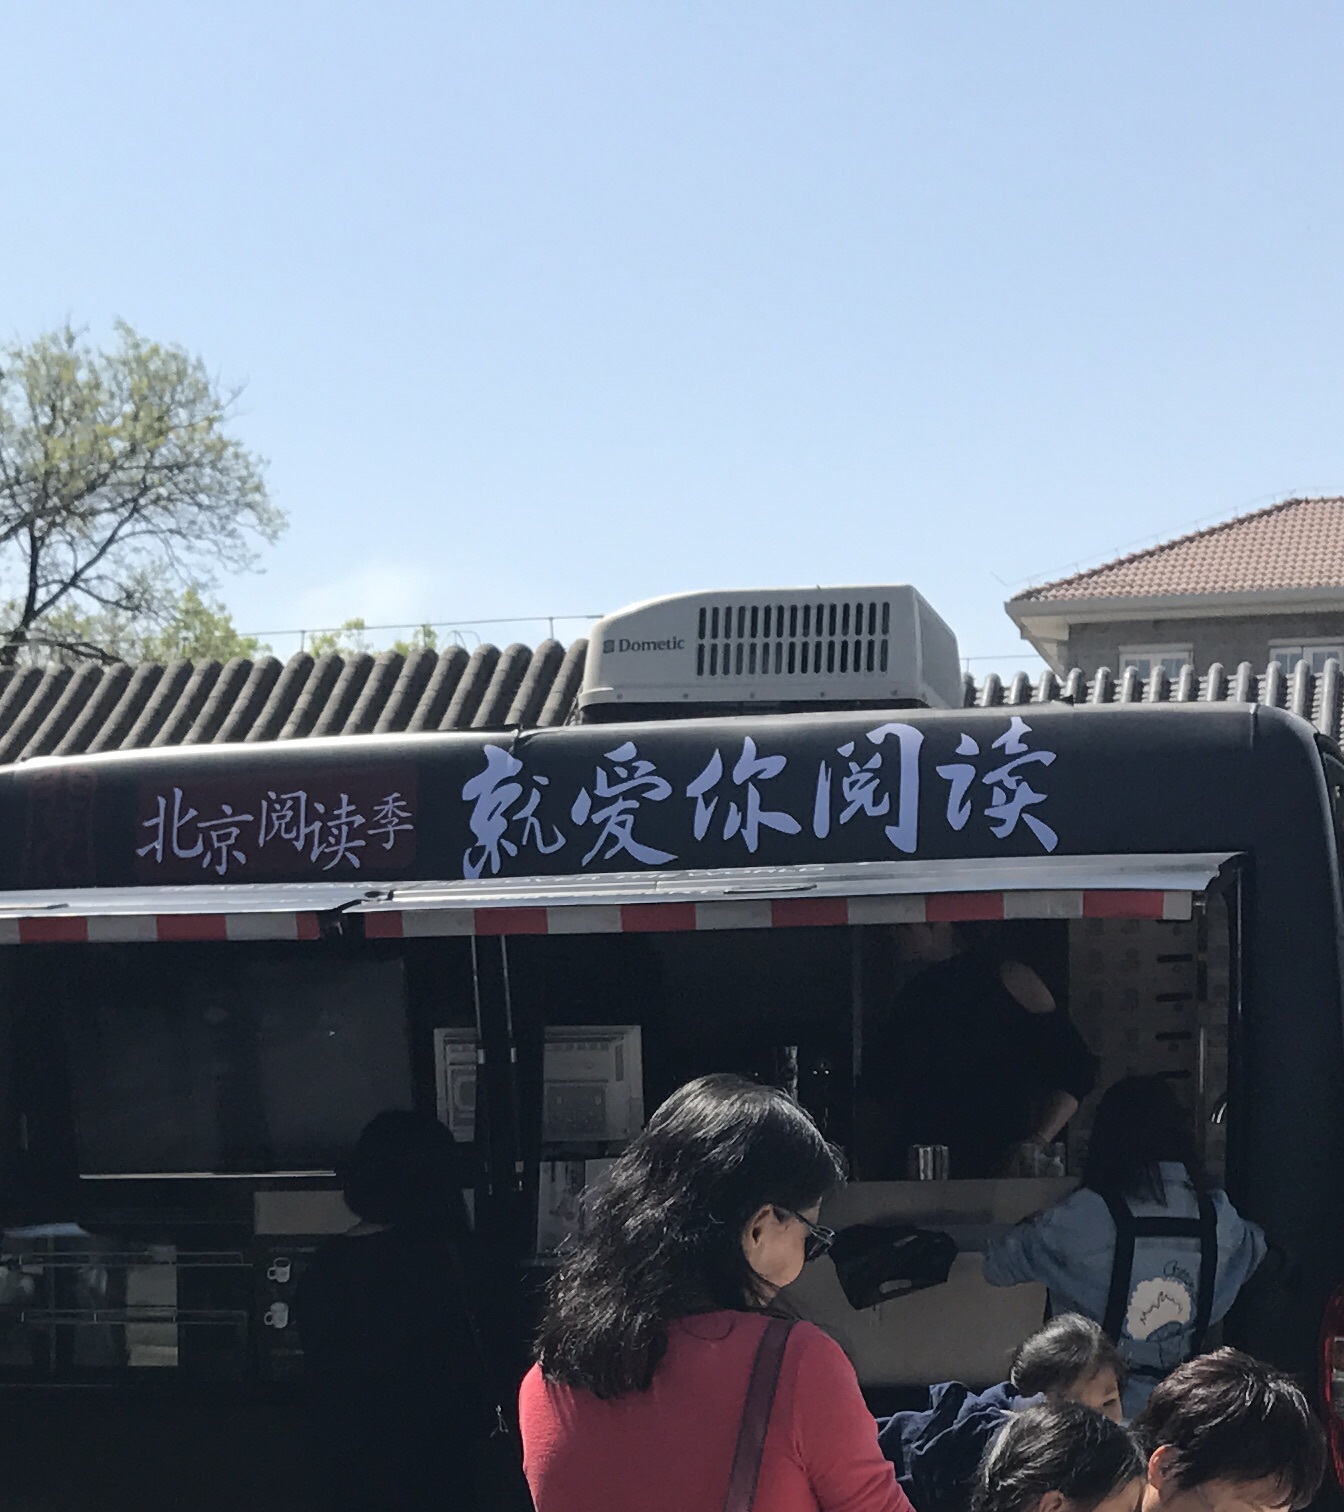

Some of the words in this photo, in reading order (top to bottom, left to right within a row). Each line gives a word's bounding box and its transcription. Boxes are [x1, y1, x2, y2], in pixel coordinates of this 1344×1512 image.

[619, 636, 685, 653] Dometic
[138, 784, 414, 876] 北京阅读季
[460, 716, 1061, 880] 就爱你阅读
